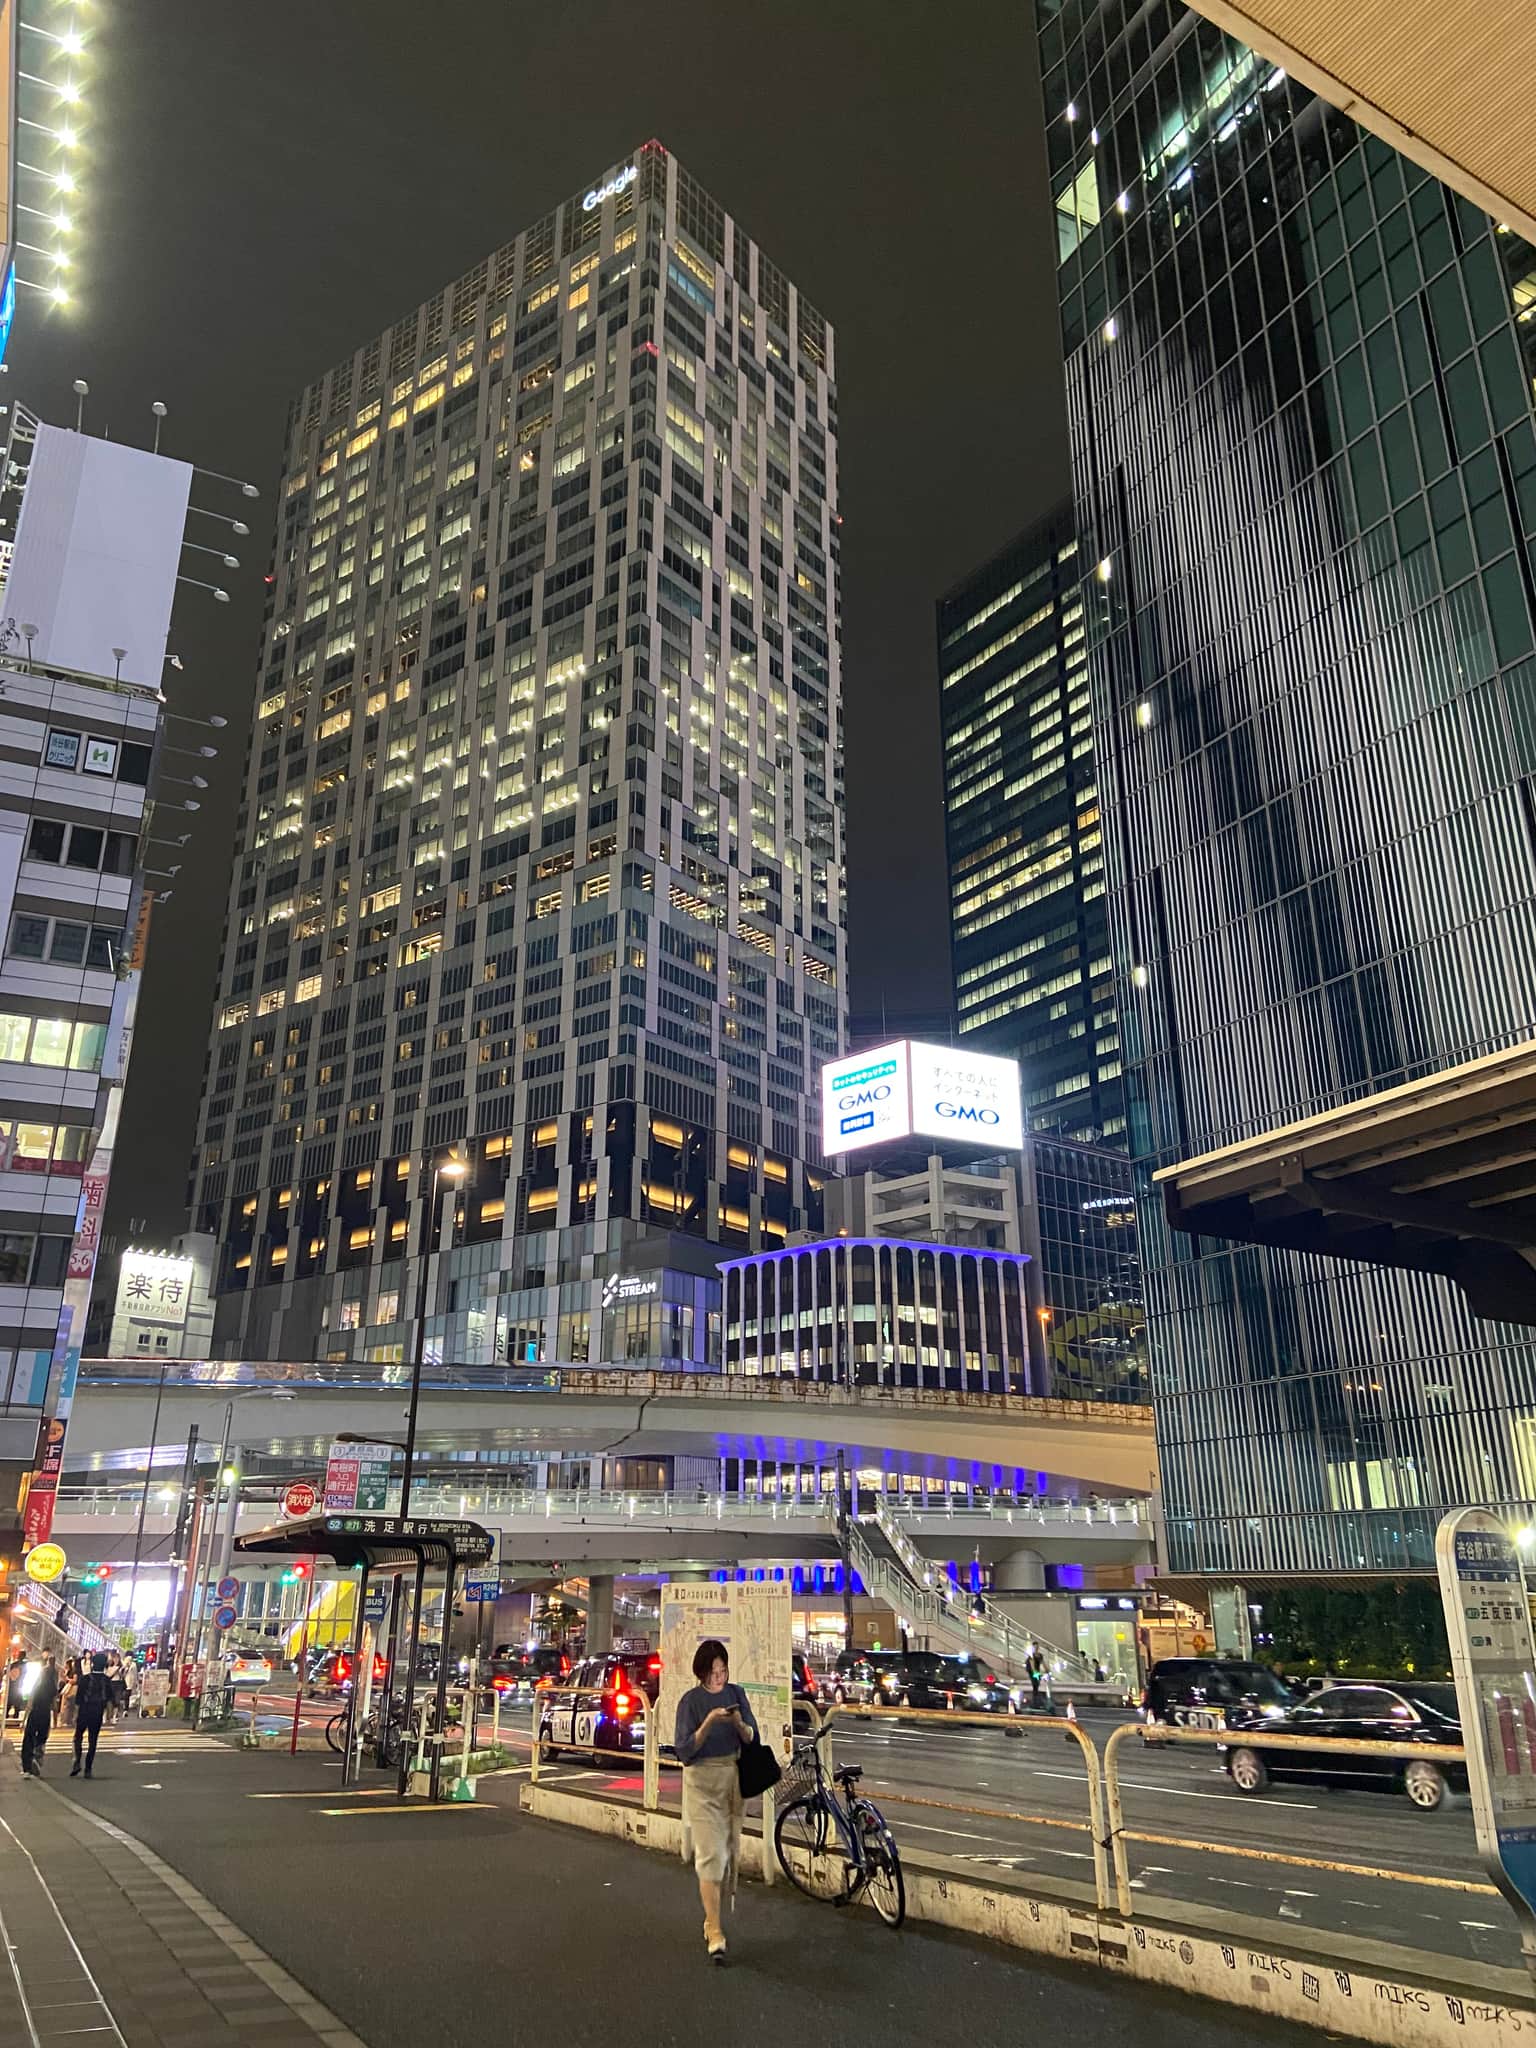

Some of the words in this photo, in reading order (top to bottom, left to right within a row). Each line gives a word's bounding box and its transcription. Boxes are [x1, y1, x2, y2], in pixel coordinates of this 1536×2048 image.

[583, 165, 638, 211] Google
[838, 1084, 892, 1111] GMO
[934, 1101, 1001, 1125] GMO
[126, 1272, 184, 1304] 楽待
[618, 1281, 657, 1298] STREAM
[329, 1462, 358, 1473] 高樹町
[326, 1480, 356, 1491] 通行止
[287, 1493, 313, 1507] 消火栓
[329, 1522, 341, 1532] 52
[364, 1520, 428, 1536] 洗足駅行
[367, 1598, 383, 1606] BUS
